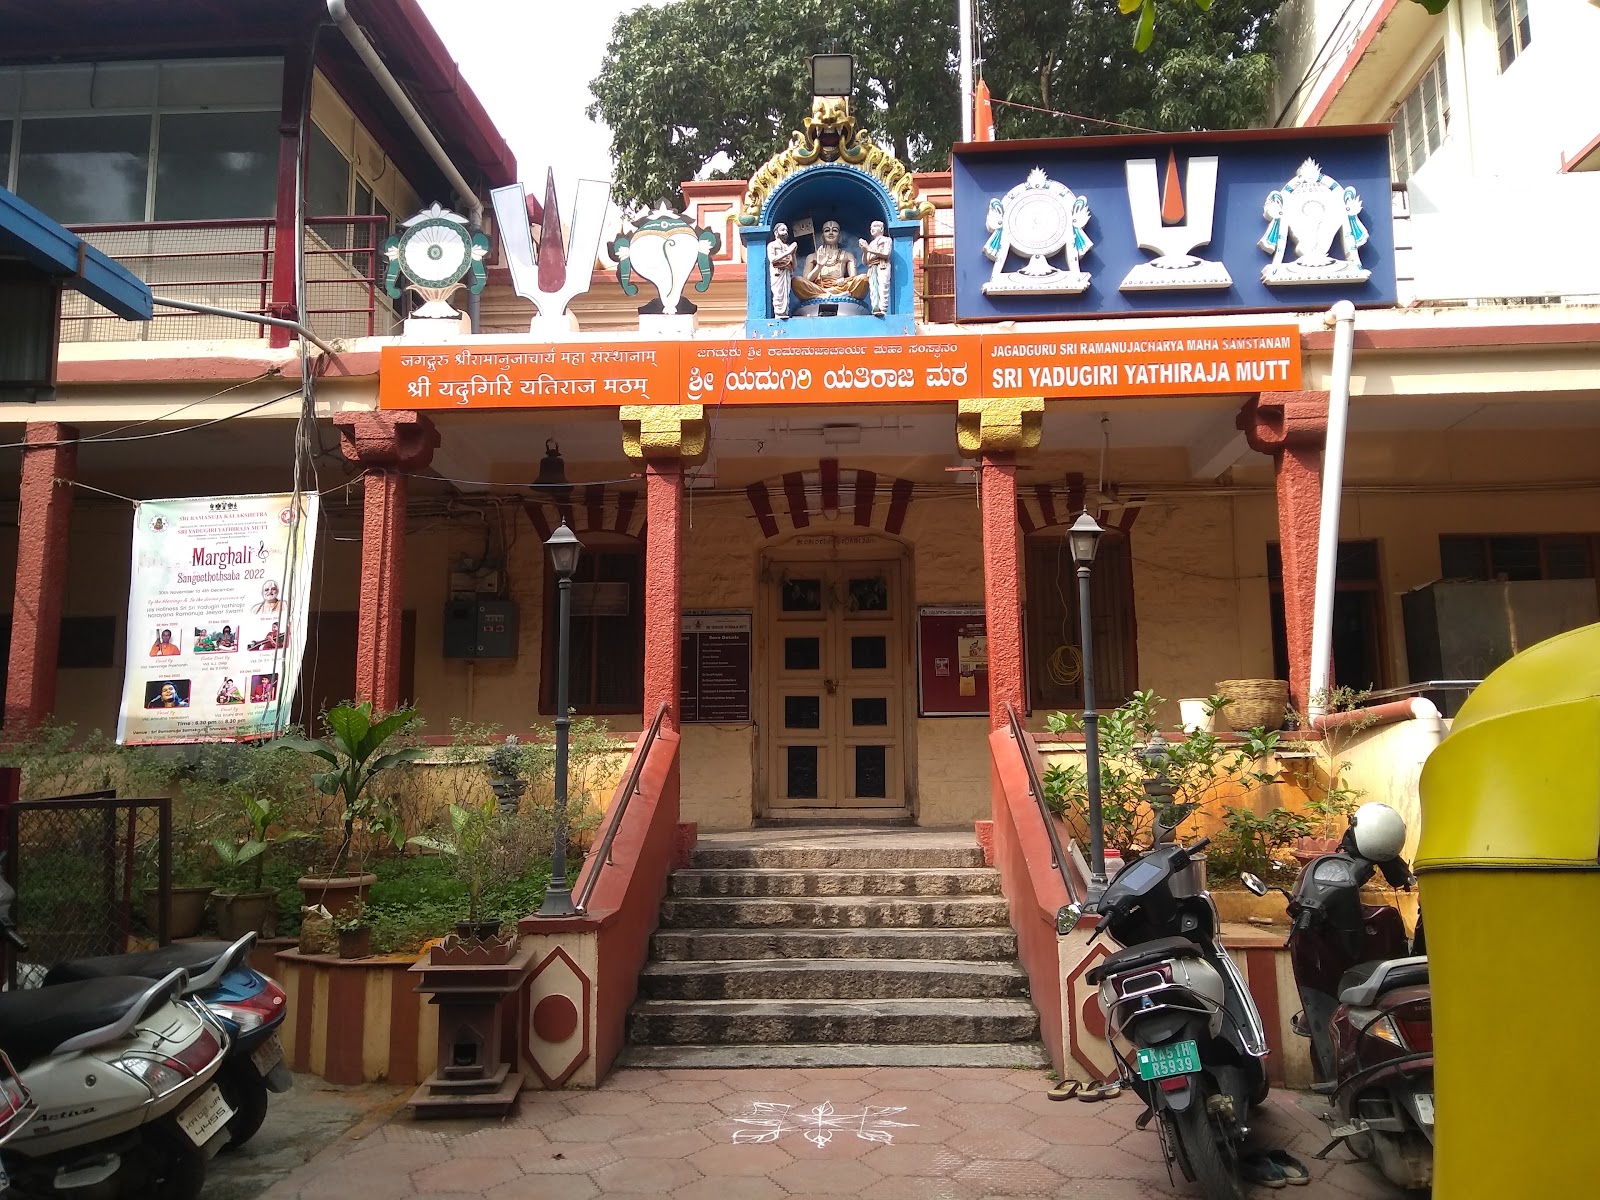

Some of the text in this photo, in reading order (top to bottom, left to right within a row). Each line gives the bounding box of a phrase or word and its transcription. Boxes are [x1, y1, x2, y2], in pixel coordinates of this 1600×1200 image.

[747, 346, 763, 361] ಶ್ರೀ
[767, 345, 867, 358] ರಾಮಾನುಜಾಚಾರ್ಯ
[873, 344, 903, 355] ಮಹಾ
[991, 336, 1291, 358] JAGADGURU SRI RAMANUJACHARYA MAHA SAMSTANAM
[454, 346, 557, 371] श्रीरामानुजाचार्य
[560, 350, 586, 366] महा
[588, 346, 658, 367] संस्थानाम्
[687, 361, 968, 401] ಶ್ರೀ ಯದುಗಿರಿ ಯತಿರಾಜ ಮಠ
[992, 359, 1291, 389] SRI YADUGIRI YATHIRAJA MUTT
[407, 373, 651, 405] श्री यदुगिरि यतिराज मठम्
[192, 545, 252, 570] Marghali
[244, 569, 265, 580] 2022
[197, 603, 220, 611] Yadugiri
[1148, 1042, 1191, 1062] KA51H
[1152, 1057, 1193, 1077] R5939
[33, 1106, 96, 1122] Activa
[185, 1116, 199, 1131] KA
[194, 1106, 227, 1135] 4455
